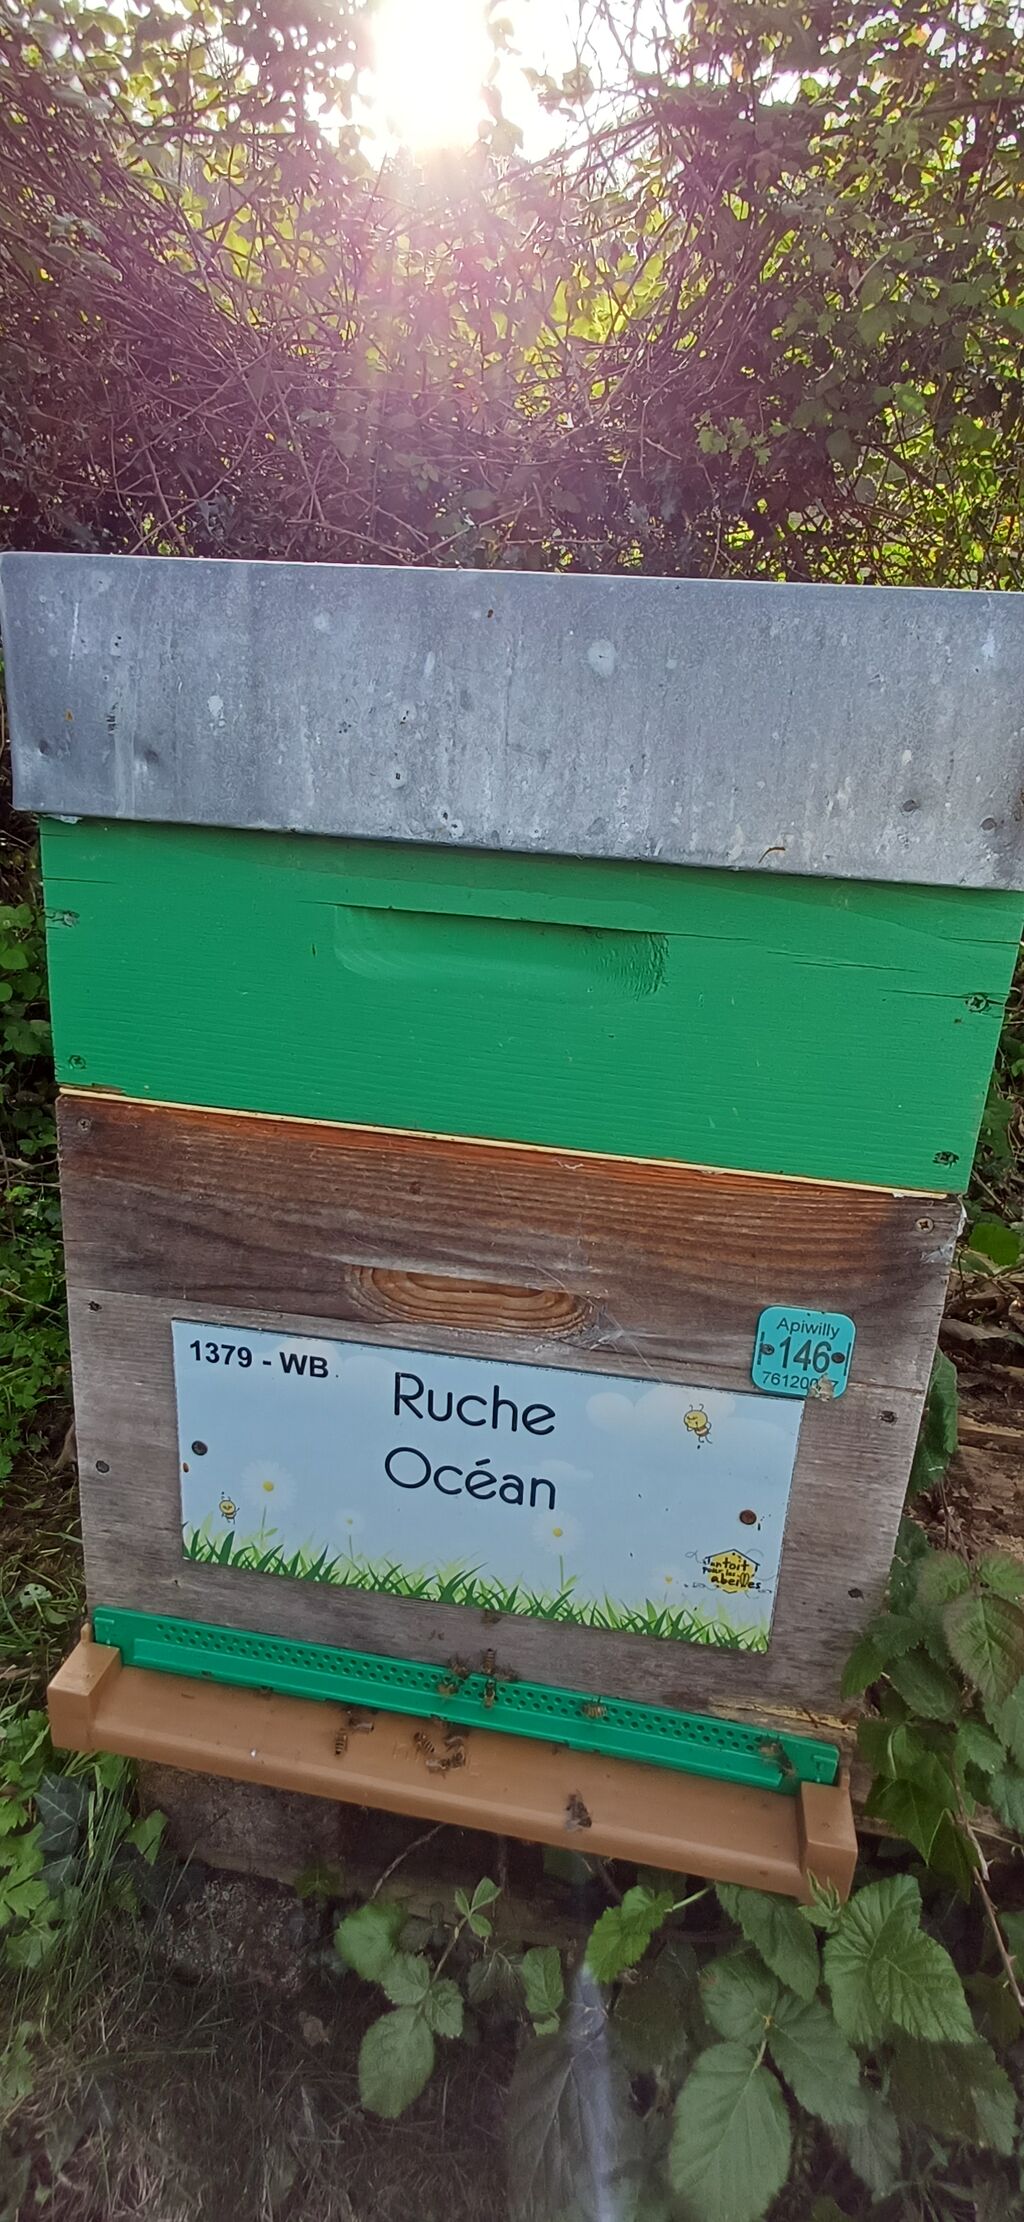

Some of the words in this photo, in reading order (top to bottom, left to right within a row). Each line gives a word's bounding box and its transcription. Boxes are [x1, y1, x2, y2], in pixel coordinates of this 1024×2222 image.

[776, 1317, 840, 1340] Apiwilly
[190, 1340, 252, 1368] 1379
[279, 1351, 329, 1378] WB
[779, 1336, 832, 1373] 146
[763, 1371, 839, 1392] 7612007
[394, 1371, 556, 1435] Ruche
[384, 1447, 556, 1510] Océan
[722, 1557, 750, 1571] toit
[710, 1572, 762, 1590] abeilles
